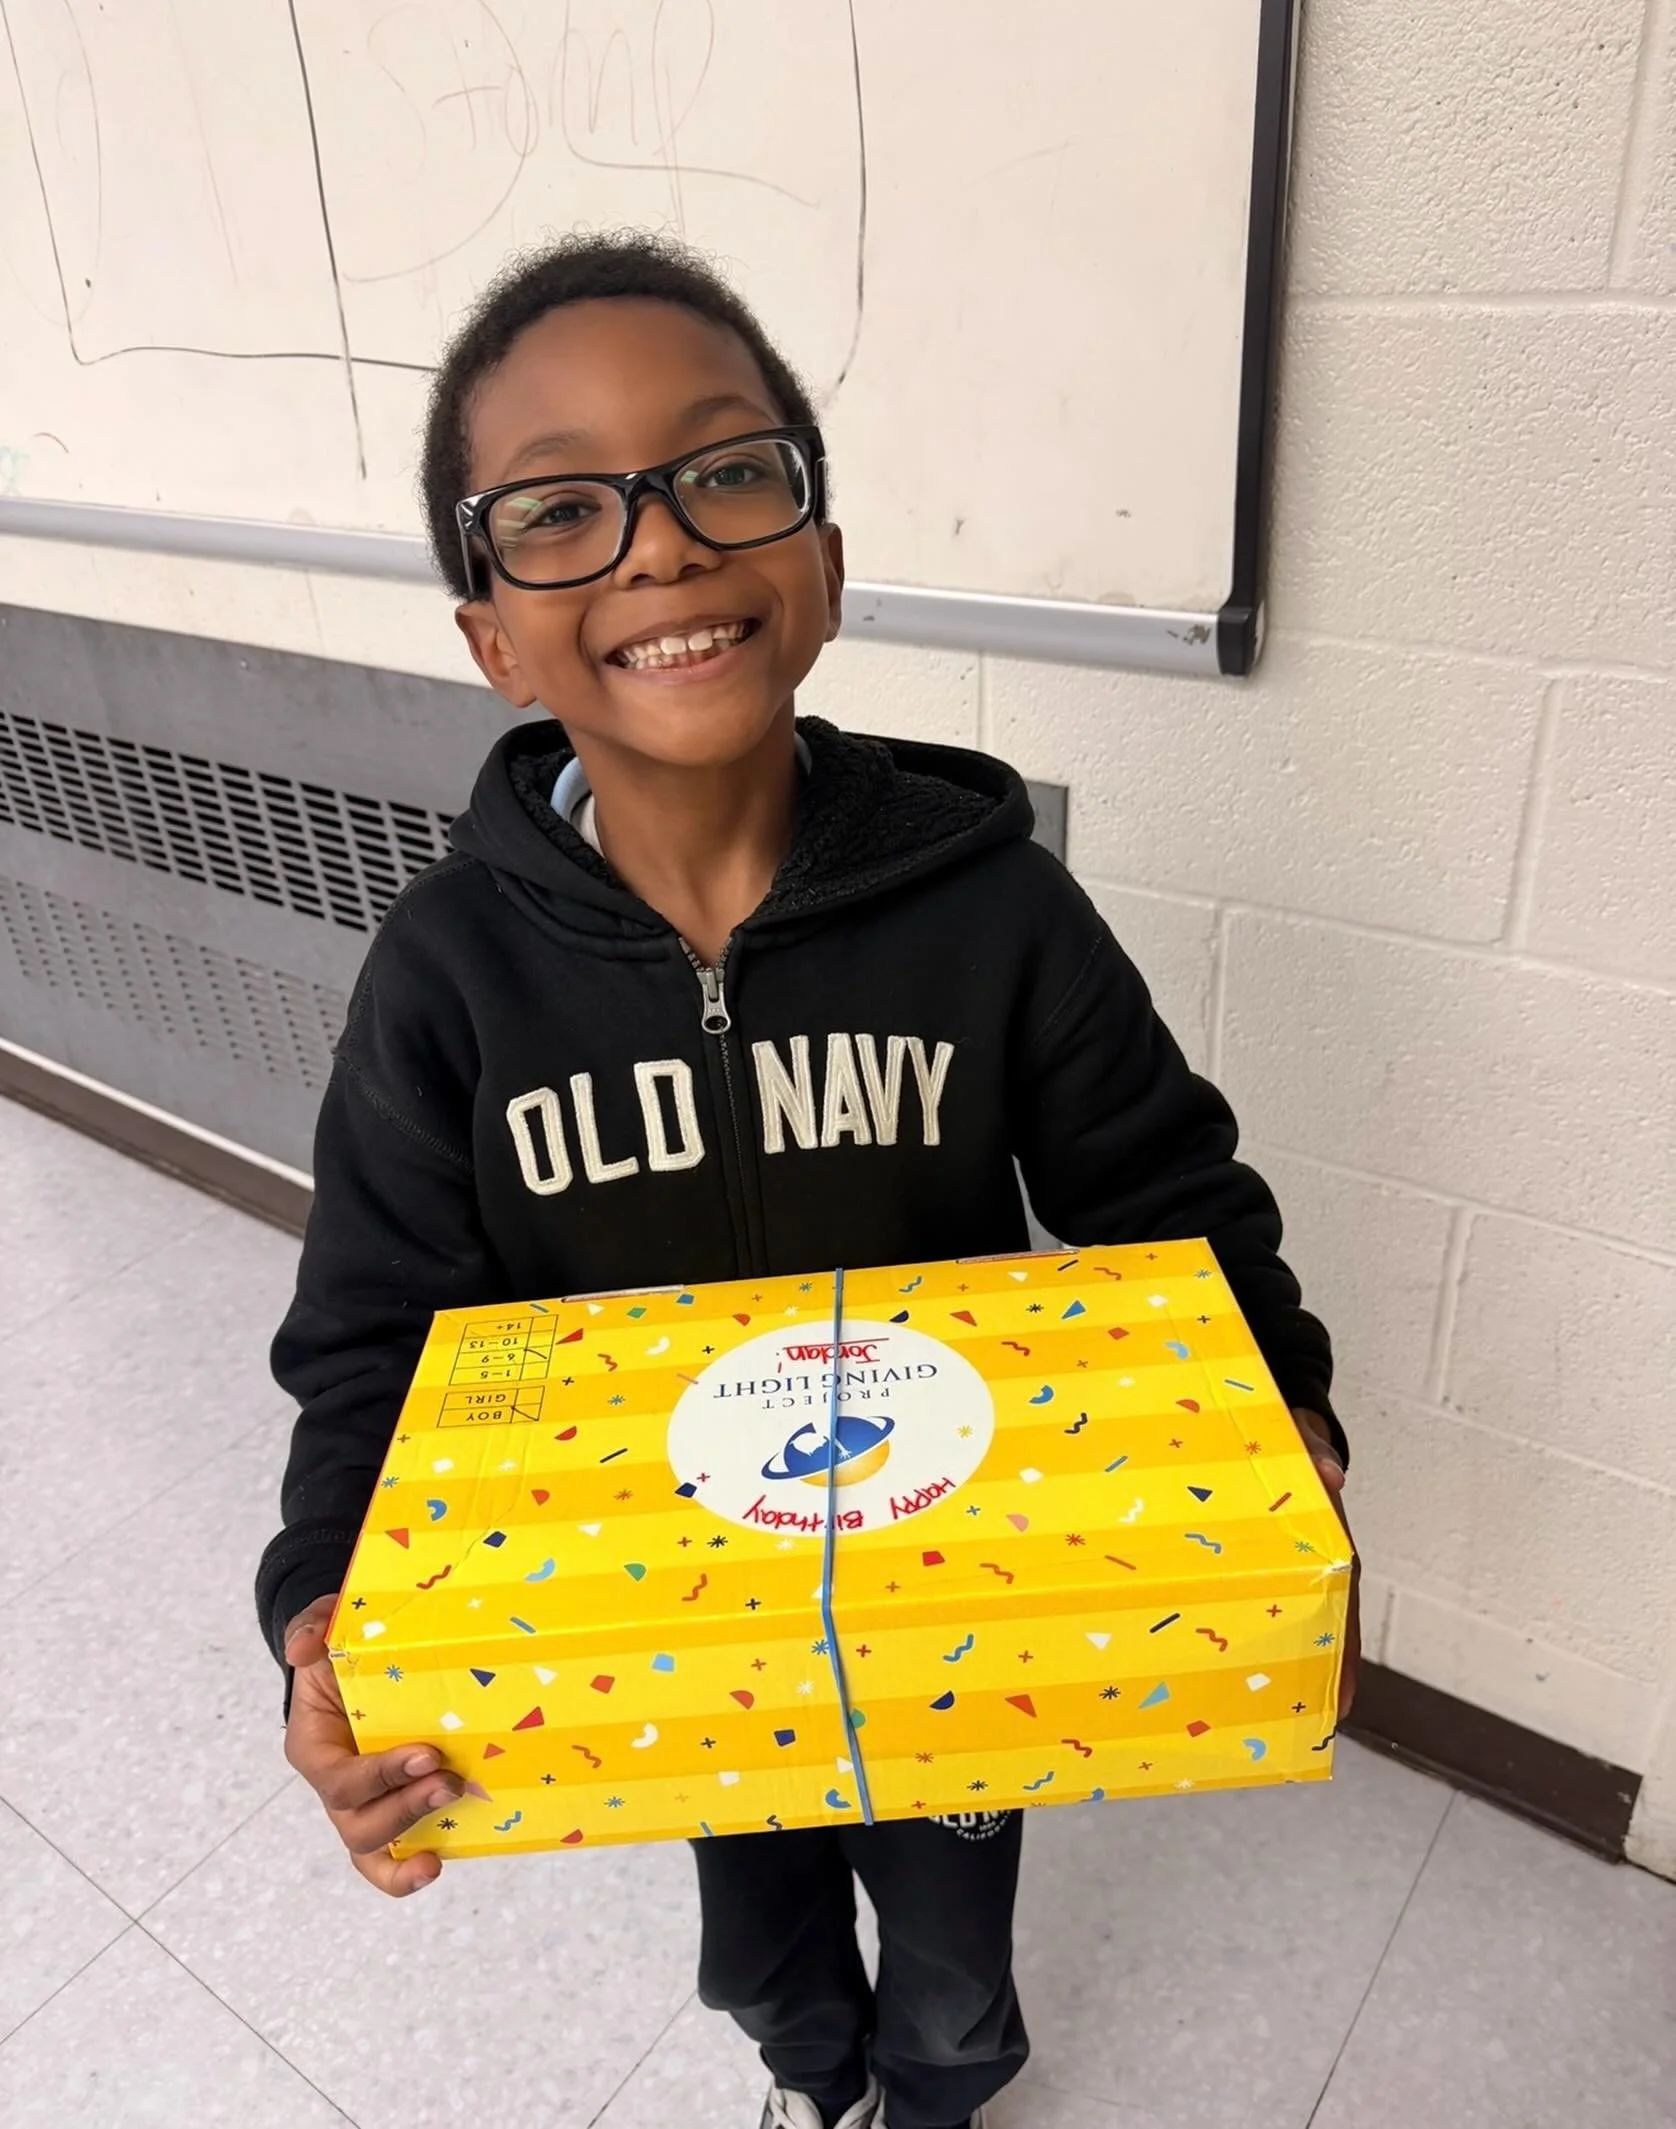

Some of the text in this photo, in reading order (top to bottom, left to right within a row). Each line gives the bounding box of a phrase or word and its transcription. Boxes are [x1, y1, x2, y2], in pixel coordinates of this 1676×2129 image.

[506, 1032, 954, 1195] OLD NAVY
[497, 1322, 522, 1331] 14+
[713, 1363, 938, 1399] GIVING LIGHT
[465, 1393, 507, 1404] GIRL
[762, 1388, 890, 1410] PROJECT
[466, 1411, 502, 1421] BOY
